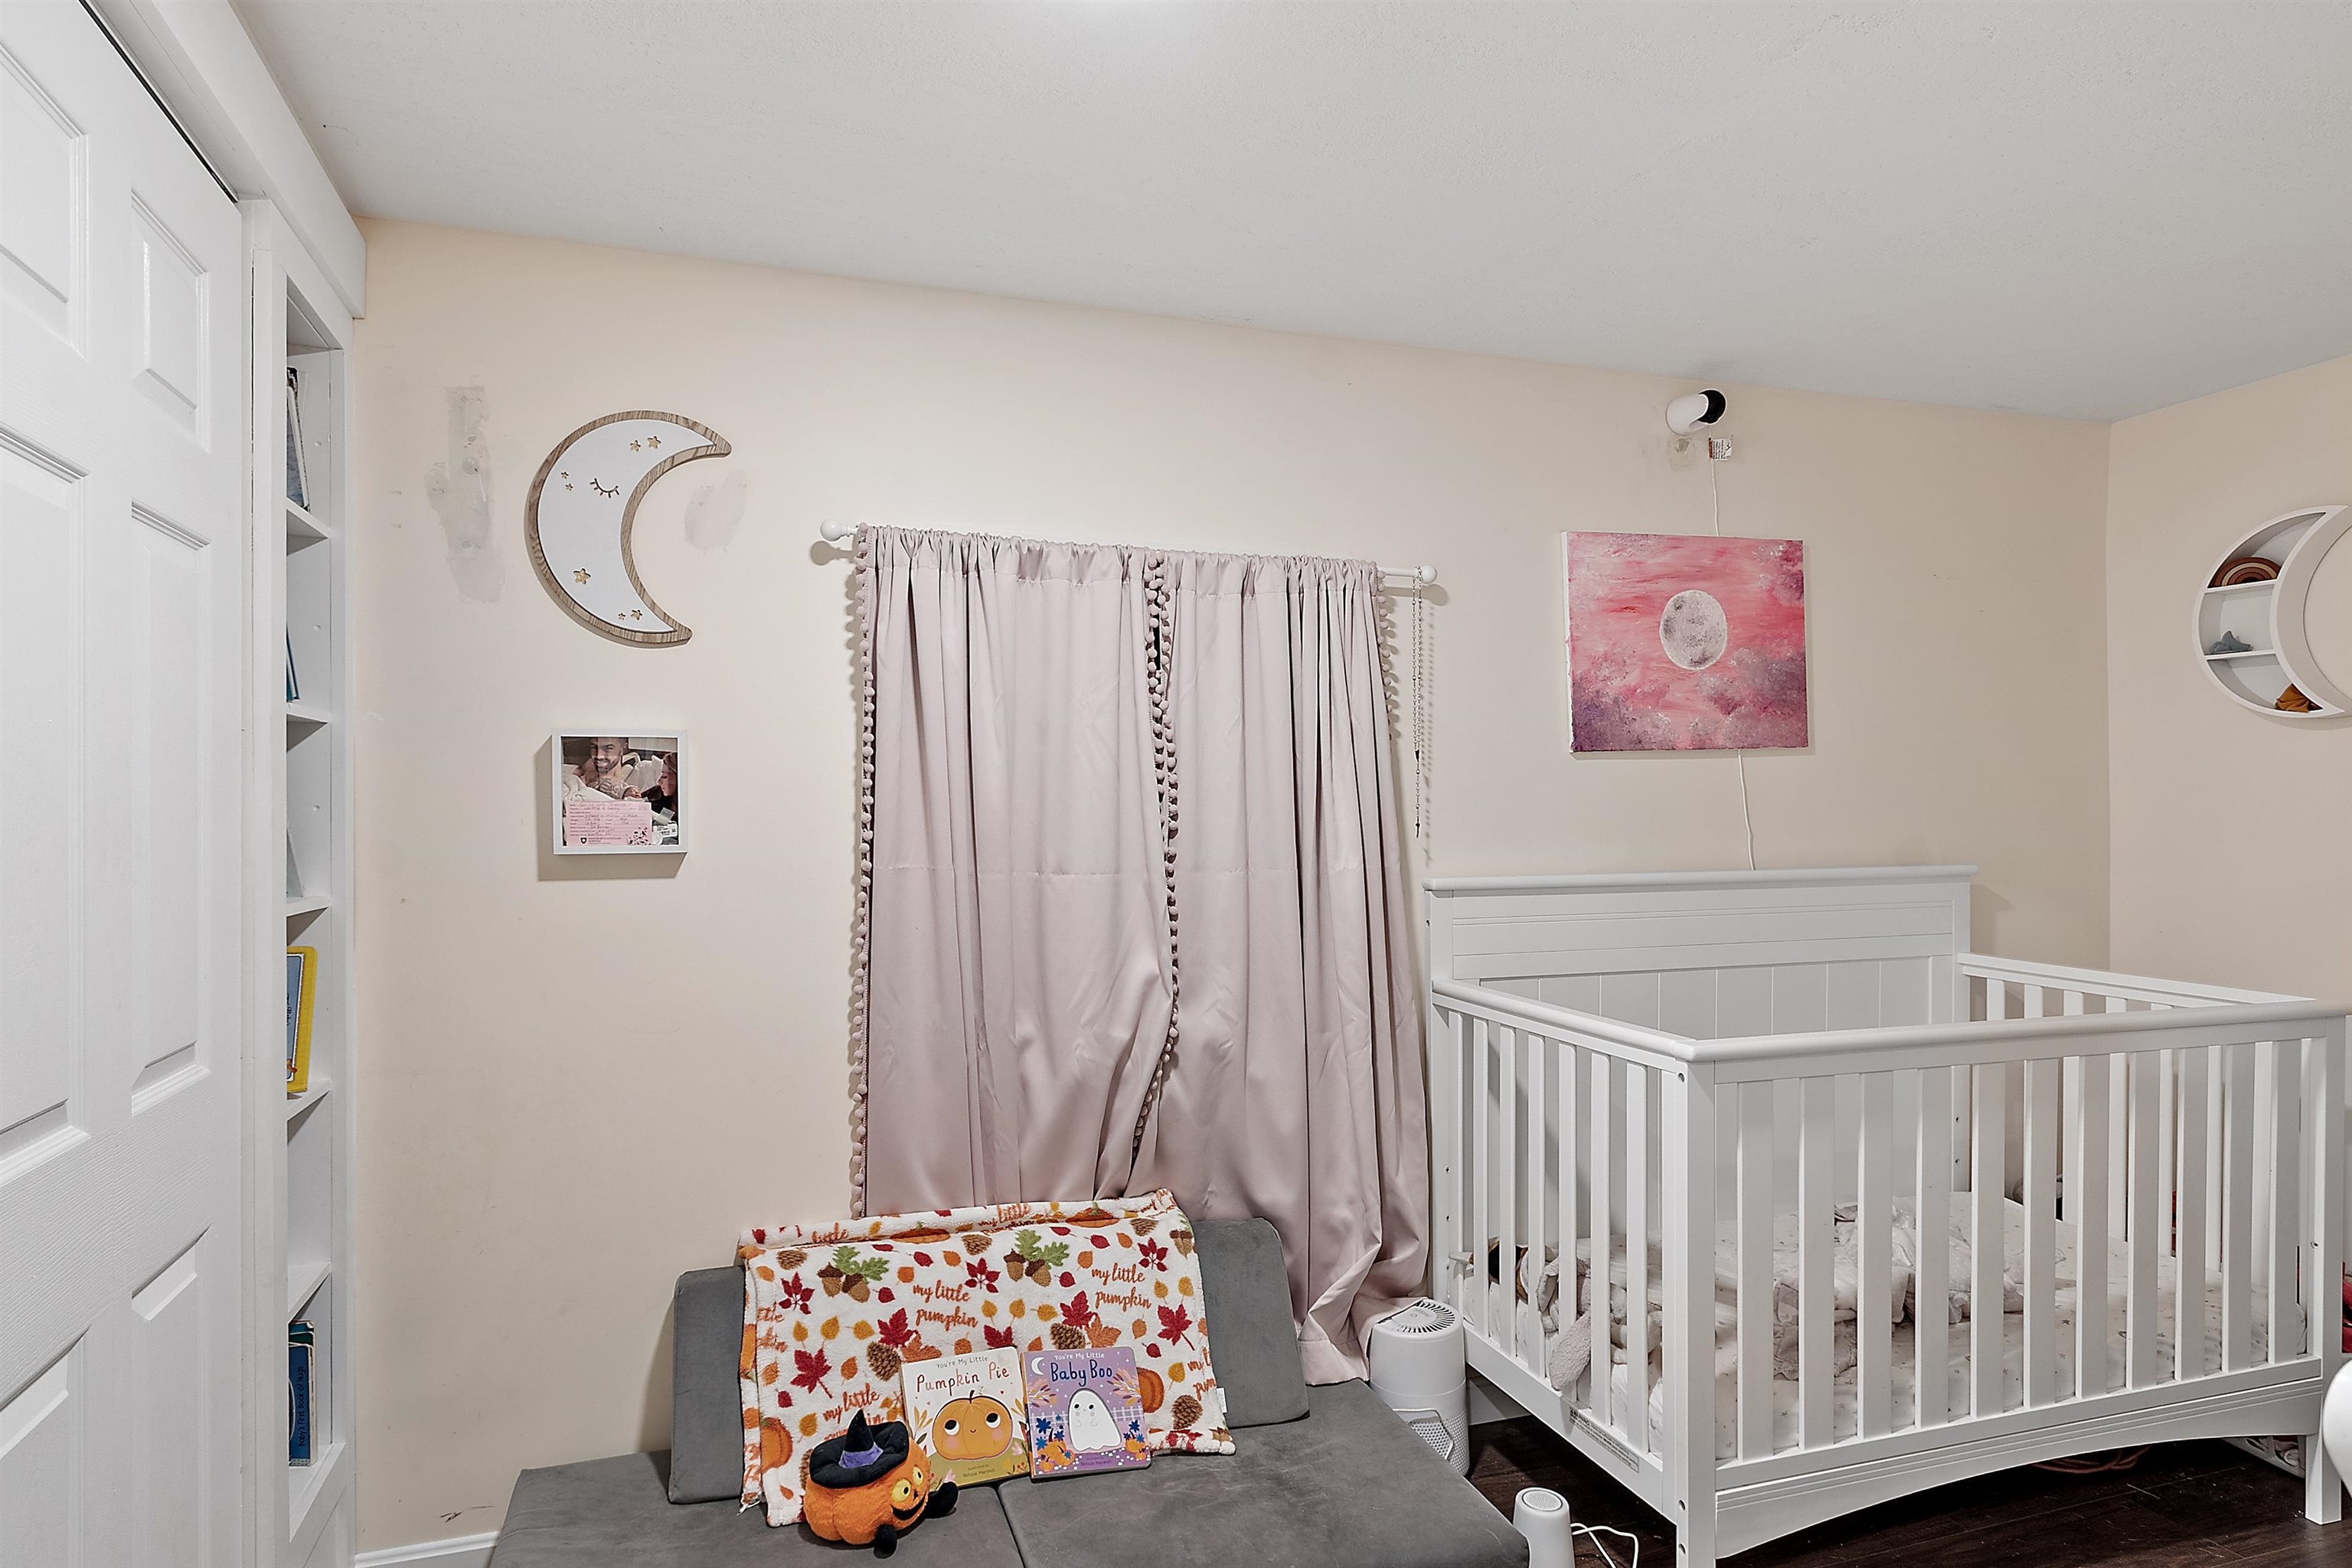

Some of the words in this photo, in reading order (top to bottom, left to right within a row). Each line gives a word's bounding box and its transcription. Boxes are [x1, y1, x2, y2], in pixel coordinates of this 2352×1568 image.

[1092, 1269, 1110, 1285] my
[1112, 1263, 1145, 1283] little
[913, 1285, 933, 1303] my
[936, 1279, 970, 1302] little
[1096, 1286, 1152, 1312] pumpkin
[916, 1306, 978, 1331] pumpkin
[297, 1366, 306, 1382] Hugs
[936, 1361, 956, 1369] You're
[1050, 1361, 1087, 1387] Baby
[1089, 1359, 1112, 1379] Boo
[296, 1383, 304, 1392] of
[916, 1368, 980, 1396] Pumpkin
[988, 1361, 1010, 1380] Pie
[823, 1405, 843, 1424] my
[843, 1383, 880, 1412] little
[298, 1426, 306, 1447] Baby's
